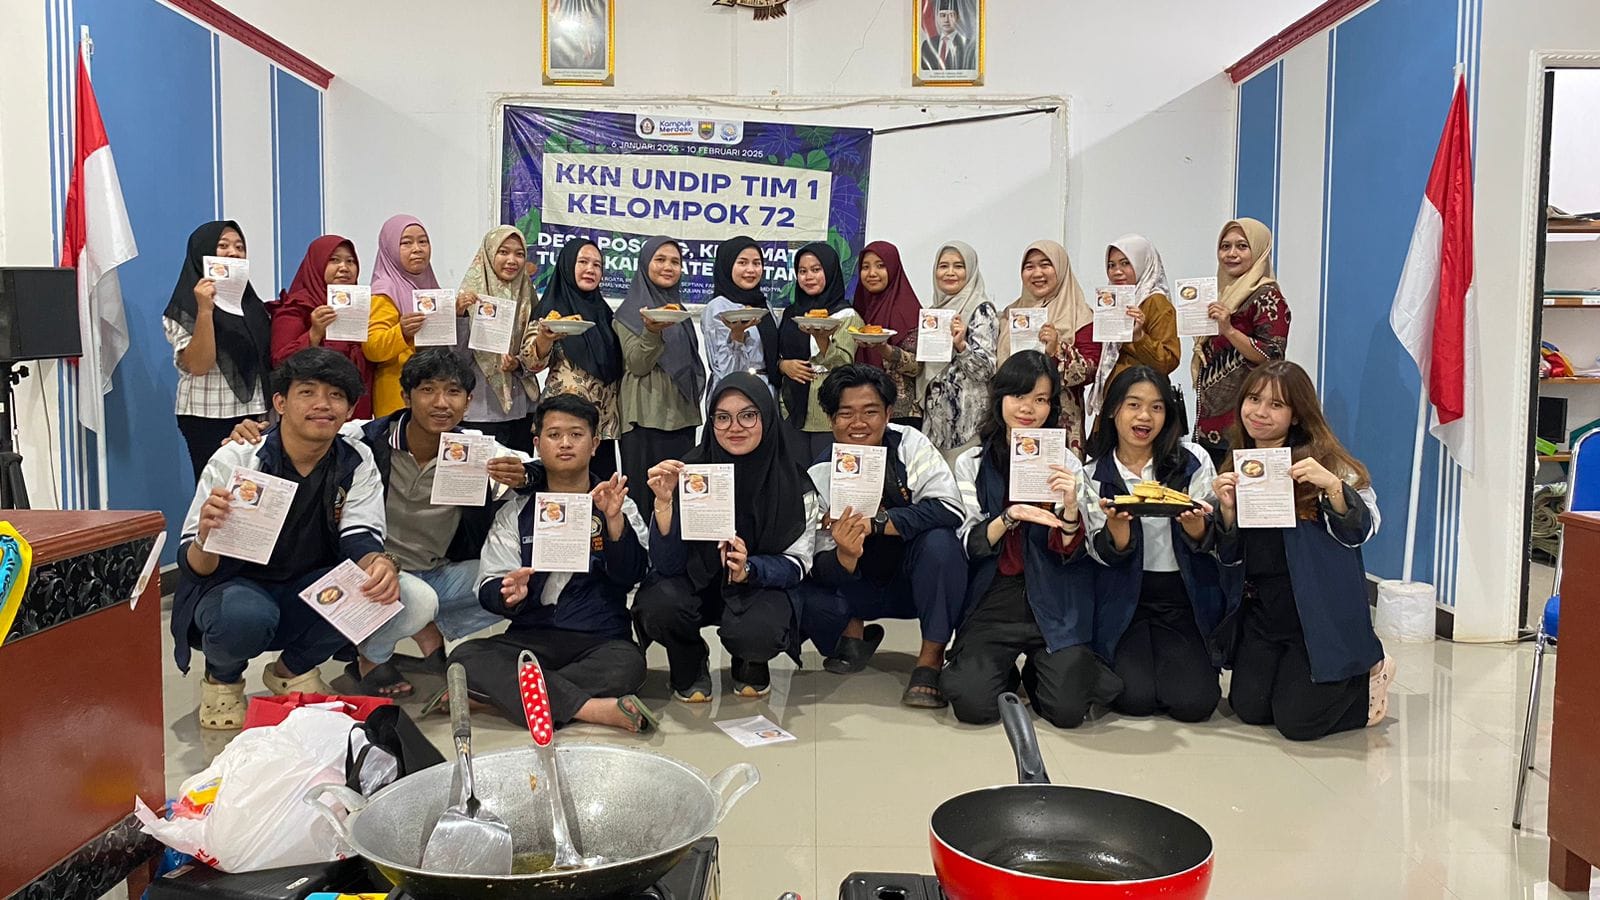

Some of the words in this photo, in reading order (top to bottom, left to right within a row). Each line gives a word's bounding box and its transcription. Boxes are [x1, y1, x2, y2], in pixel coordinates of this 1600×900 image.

[659, 119, 692, 129] Kampus
[618, 142, 656, 151] JANUARI
[657, 144, 679, 153] 2025
[687, 146, 696, 154] 10
[698, 147, 740, 157] FEBRUARI
[742, 149, 763, 158] 2025
[556, 163, 622, 188] KKN
[632, 168, 731, 195] UNDIP
[741, 175, 797, 199] TIM
[807, 179, 818, 200] 1
[568, 193, 750, 226] KELOMPOK
[759, 206, 795, 228] 72
